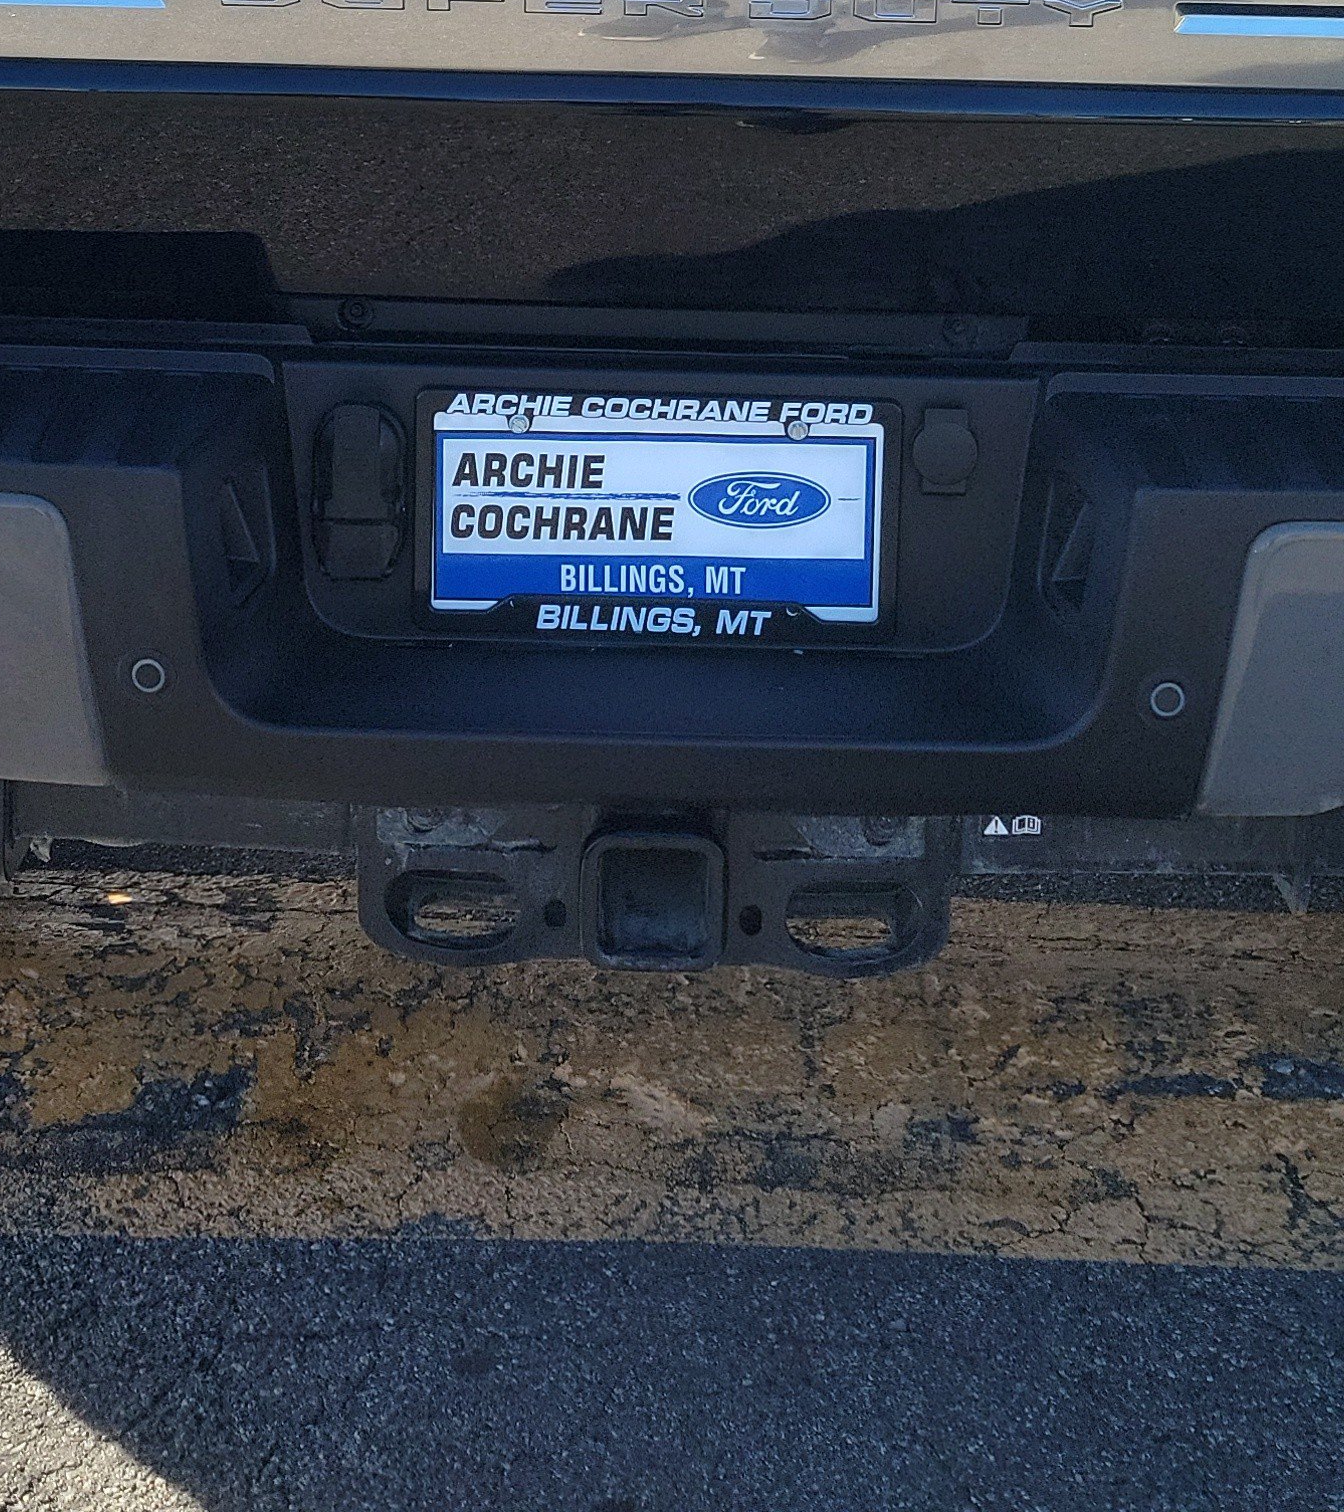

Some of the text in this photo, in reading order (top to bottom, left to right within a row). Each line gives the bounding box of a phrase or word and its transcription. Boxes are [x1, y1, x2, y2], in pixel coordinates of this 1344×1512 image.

[446, 392, 875, 425] ARCHIE COCHRANE FORD
[452, 452, 606, 489] ARCHIE
[717, 479, 801, 518] Ford
[450, 504, 675, 542] COCHRANE
[560, 564, 746, 598] BILLINGS, MT
[536, 604, 772, 637] BILLINGS, MT
